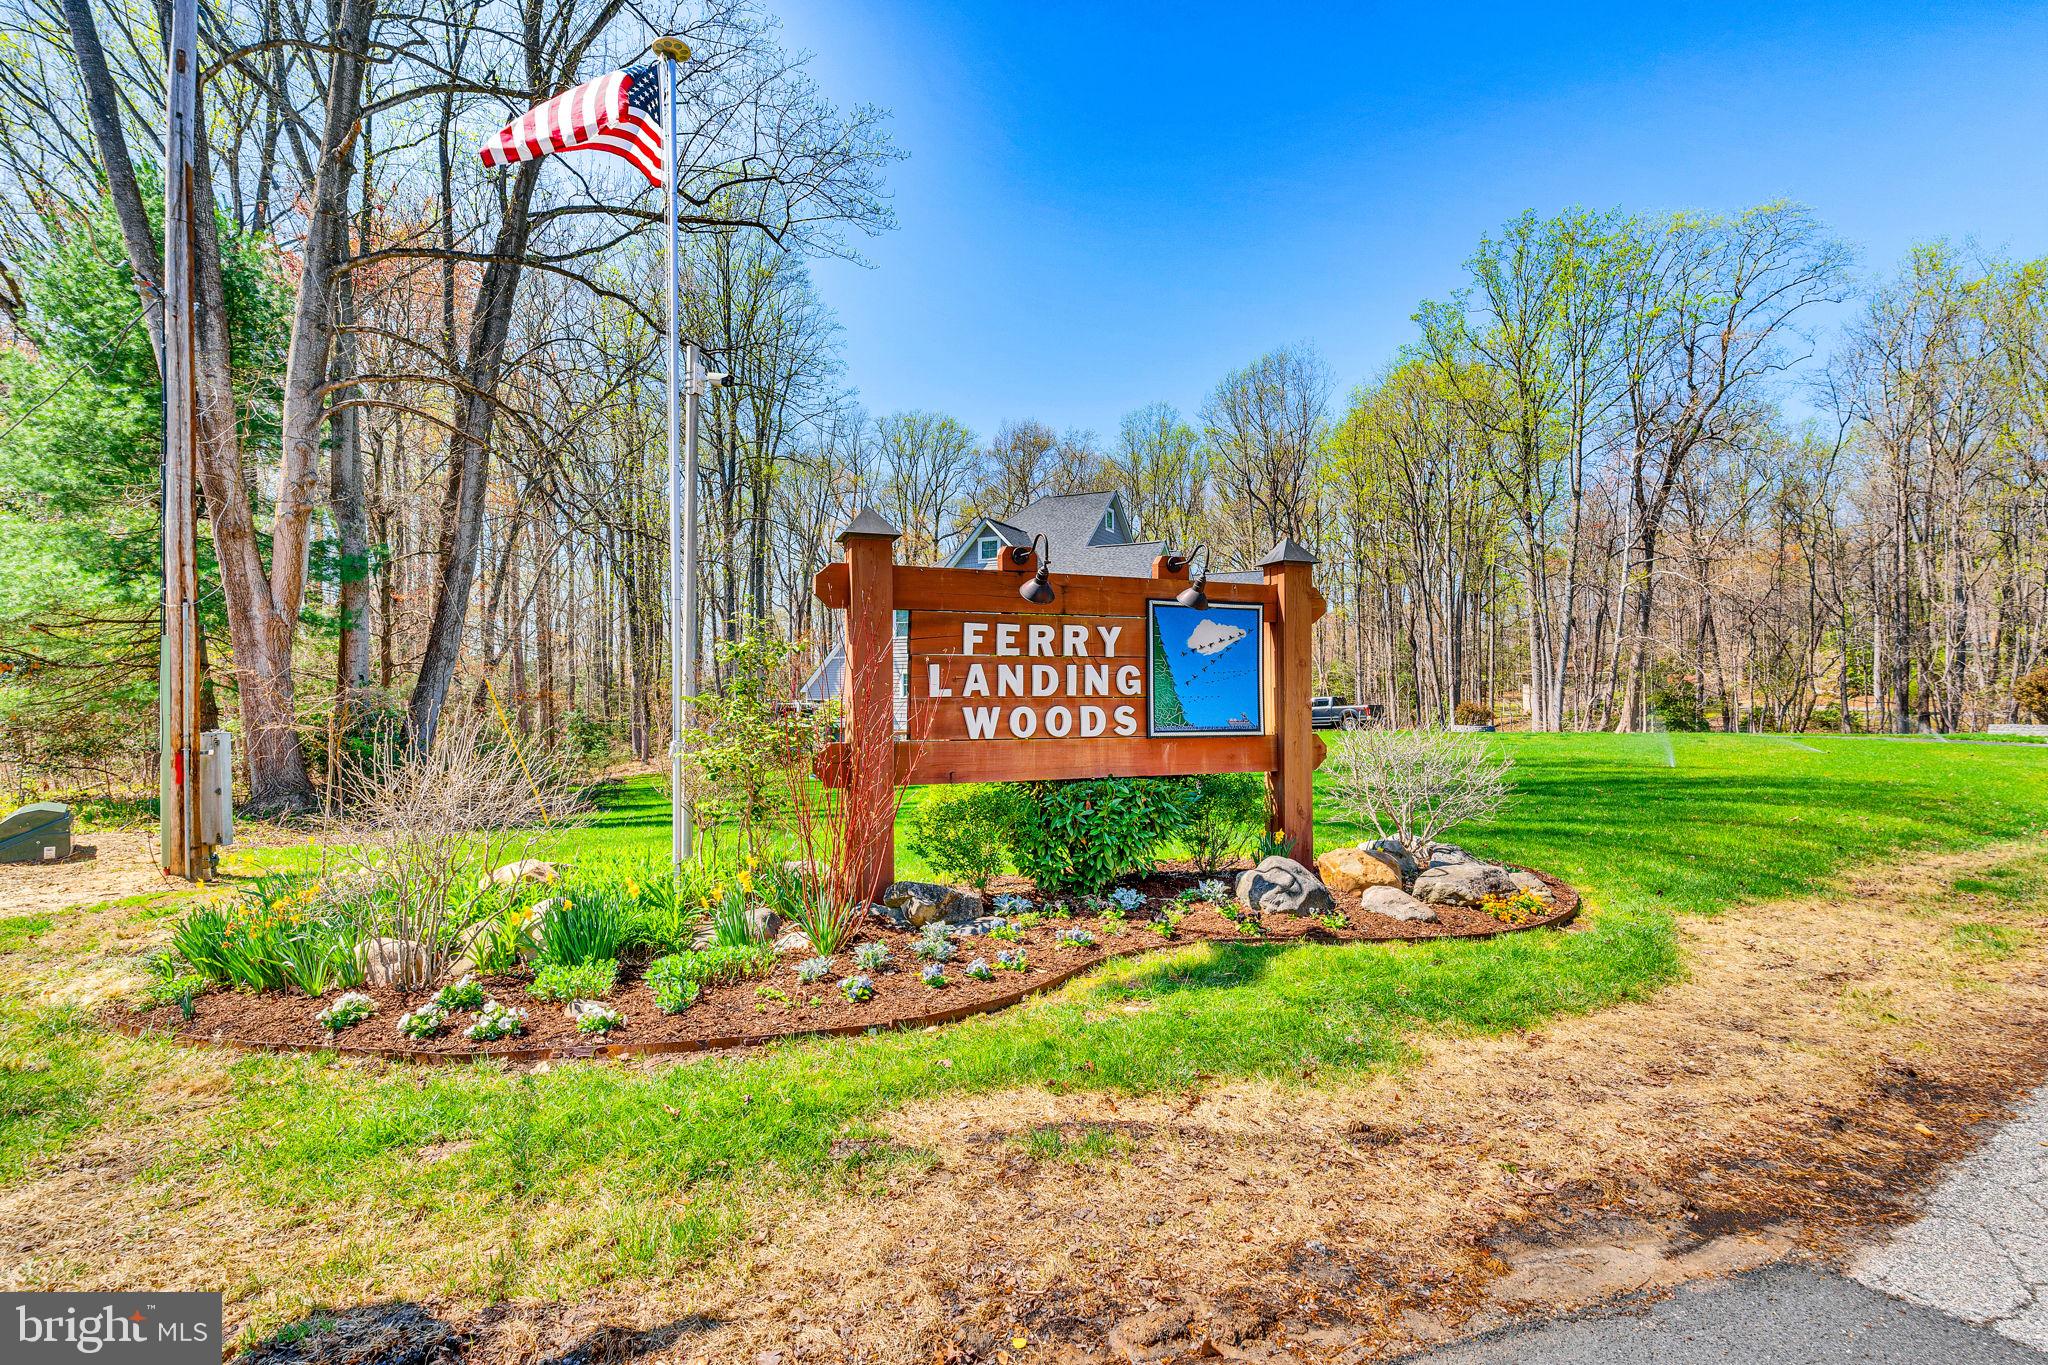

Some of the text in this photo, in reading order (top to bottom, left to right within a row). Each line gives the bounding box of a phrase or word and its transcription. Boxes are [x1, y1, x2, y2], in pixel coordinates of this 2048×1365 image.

[963, 622, 1122, 657] FERRY
[929, 664, 1142, 697] LANDING
[962, 706, 1138, 739] WOODS
